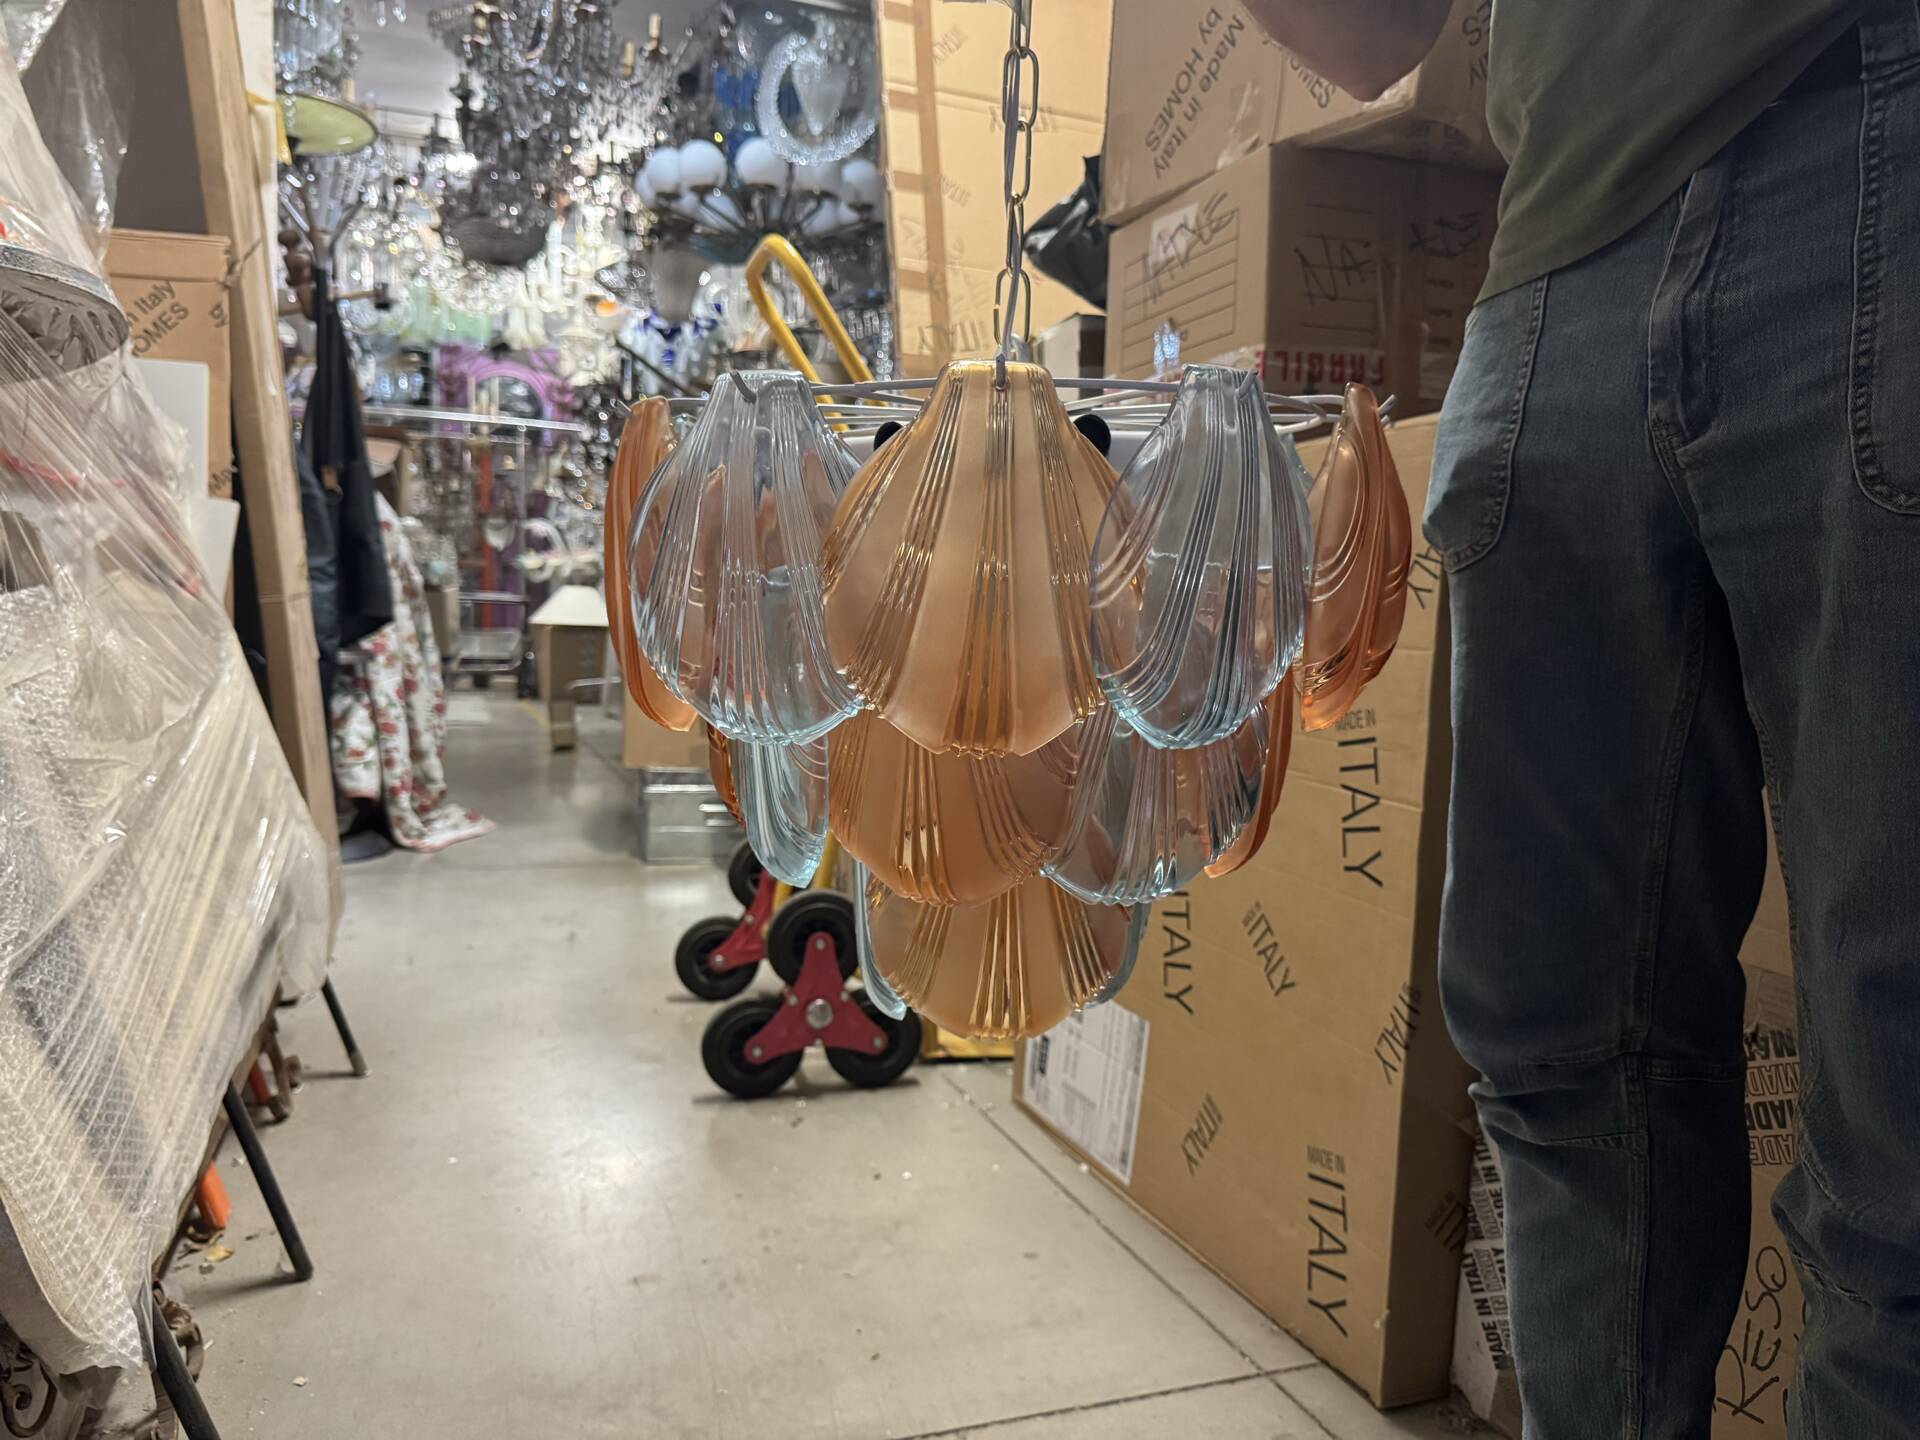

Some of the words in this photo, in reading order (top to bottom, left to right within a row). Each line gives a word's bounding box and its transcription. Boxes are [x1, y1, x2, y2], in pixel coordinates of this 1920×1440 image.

[1200, 15, 1245, 93] Made
[1145, 47, 1204, 152] HOMES
[1153, 125, 1188, 179] Italy
[134, 281, 175, 315] Italy
[131, 301, 189, 358] OMES
[1337, 736, 1384, 888] ITALY
[1247, 912, 1296, 997] ITALY
[1374, 993, 1420, 1085] ITALY
[1746, 1062, 1800, 1096] MAD
[1750, 1134, 1793, 1166] ADE
[1308, 1172, 1348, 1337] ITALY
[1474, 1298, 1493, 1316] IN
[1482, 1320, 1505, 1370] MADE
